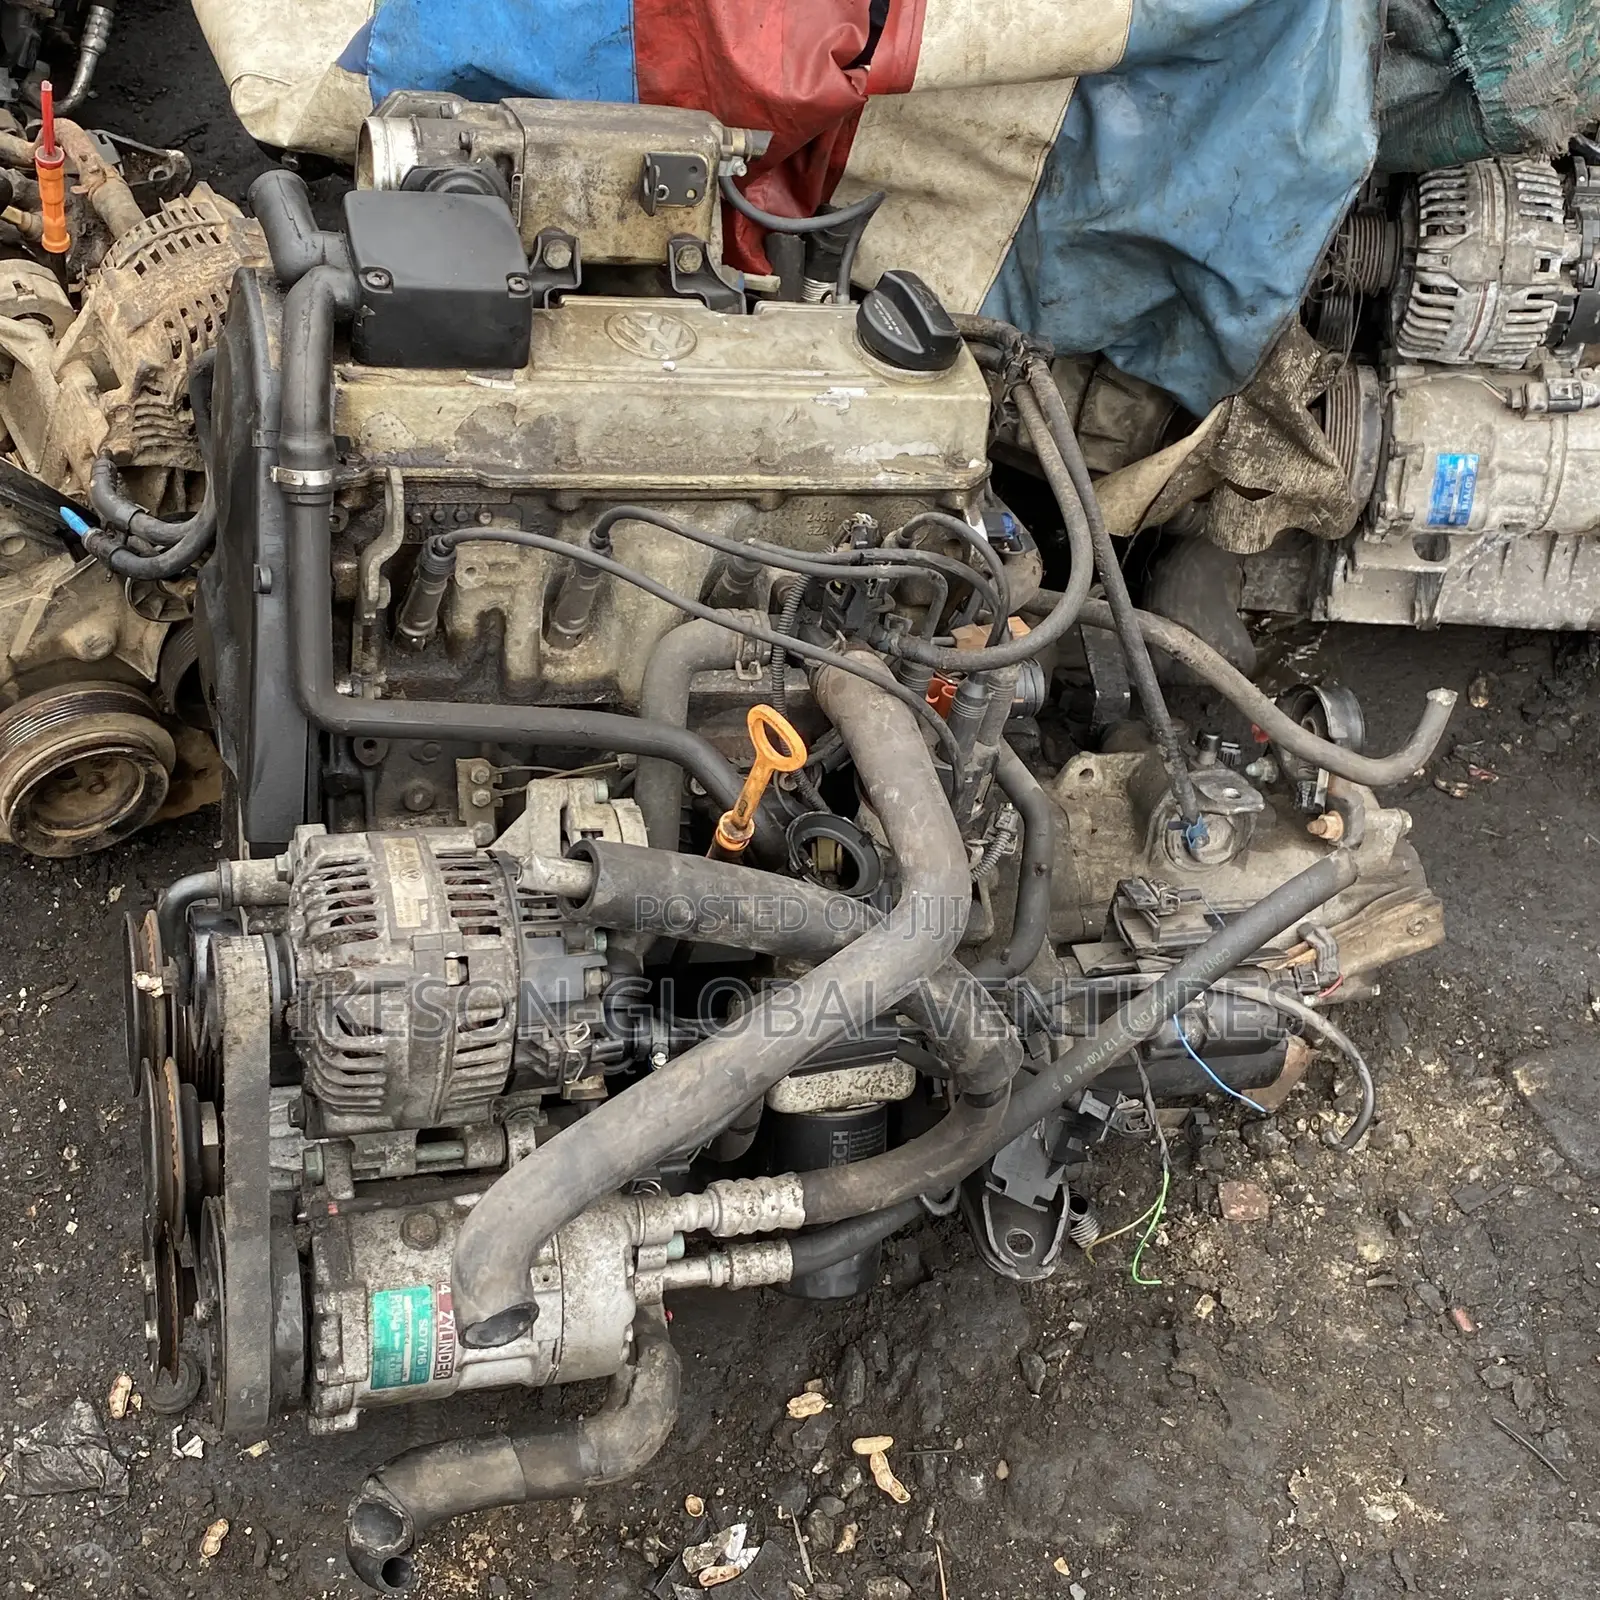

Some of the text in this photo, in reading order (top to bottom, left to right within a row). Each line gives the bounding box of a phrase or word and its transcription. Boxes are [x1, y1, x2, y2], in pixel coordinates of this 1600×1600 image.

[417, 1318, 429, 1365] SD7V16
[434, 1284, 454, 1378] 4 ZYLINDER
